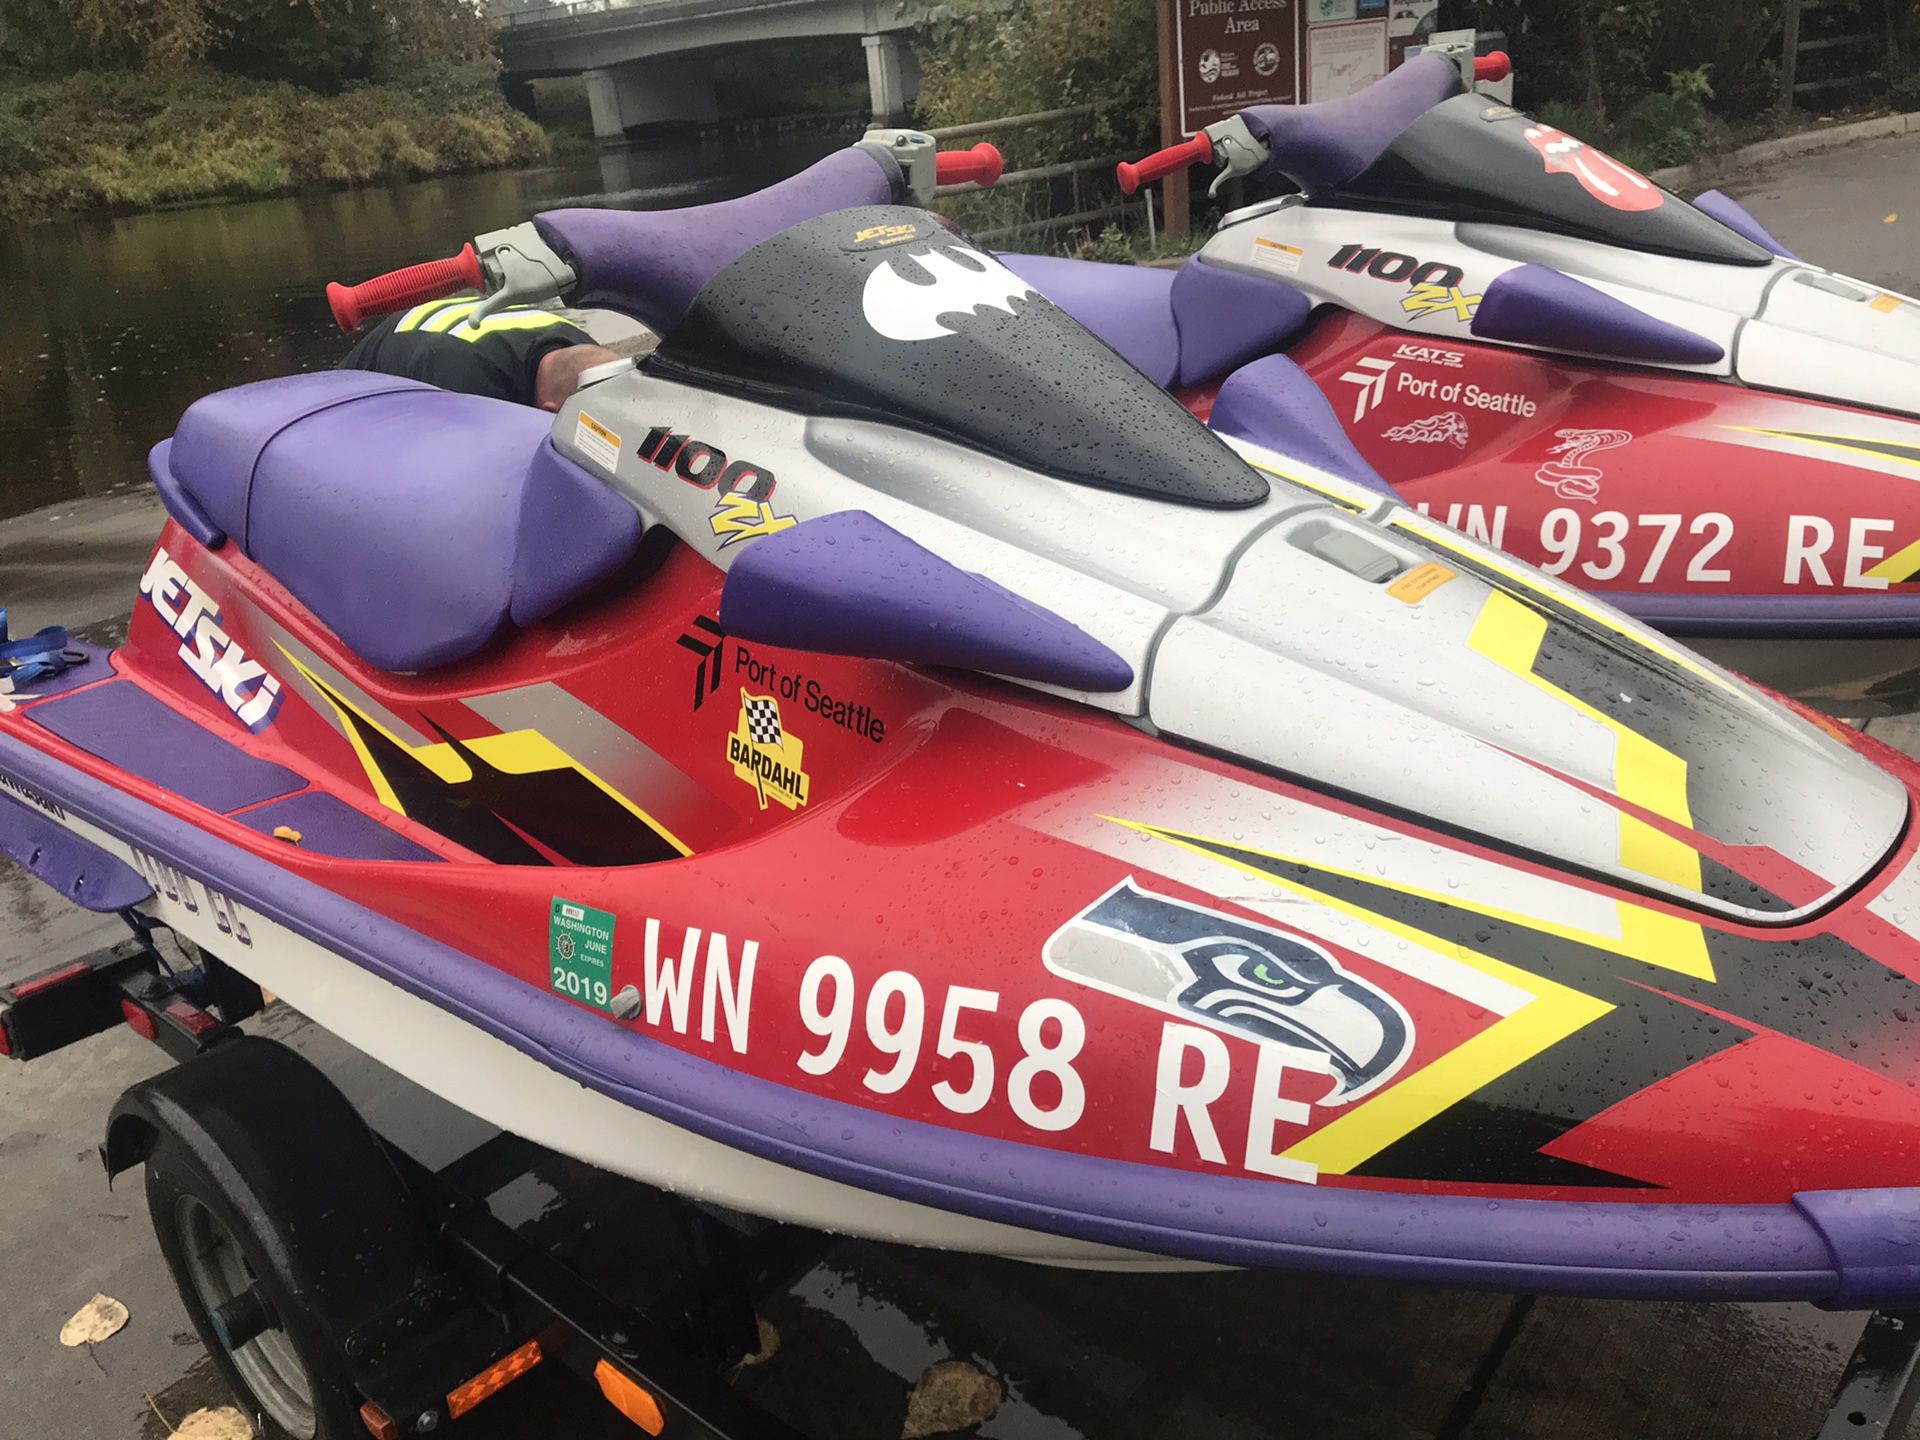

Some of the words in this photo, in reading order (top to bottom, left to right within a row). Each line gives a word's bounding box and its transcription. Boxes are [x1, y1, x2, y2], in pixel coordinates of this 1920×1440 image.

[1189, 0, 1235, 16] Public
[1238, 0, 1288, 12] Access
[1224, 16, 1260, 34] Area
[1326, 243, 1465, 288] 1100
[1400, 281, 1485, 323] ZX
[1396, 343, 1465, 364] KATS
[1397, 372, 1438, 400] Port
[1440, 382, 1463, 403] of
[1463, 384, 1537, 418] Seattle
[636, 426, 777, 501] 1100
[708, 491, 799, 552] ZX
[1537, 507, 1735, 584] 9372
[1783, 514, 1896, 590] RE
[735, 646, 777, 691] Port
[780, 675, 802, 702] of
[804, 680, 885, 744] Seattle
[730, 737, 804, 801] BARDAHL
[553, 915, 610, 941] WASHINGTON
[584, 940, 607, 955] JUNE
[580, 953, 605, 968] EXPIRES
[553, 966, 608, 1006] 2019
[643, 917, 760, 1055] WN
[796, 954, 1087, 1132] 9958
[1149, 1020, 1332, 1185] RE
